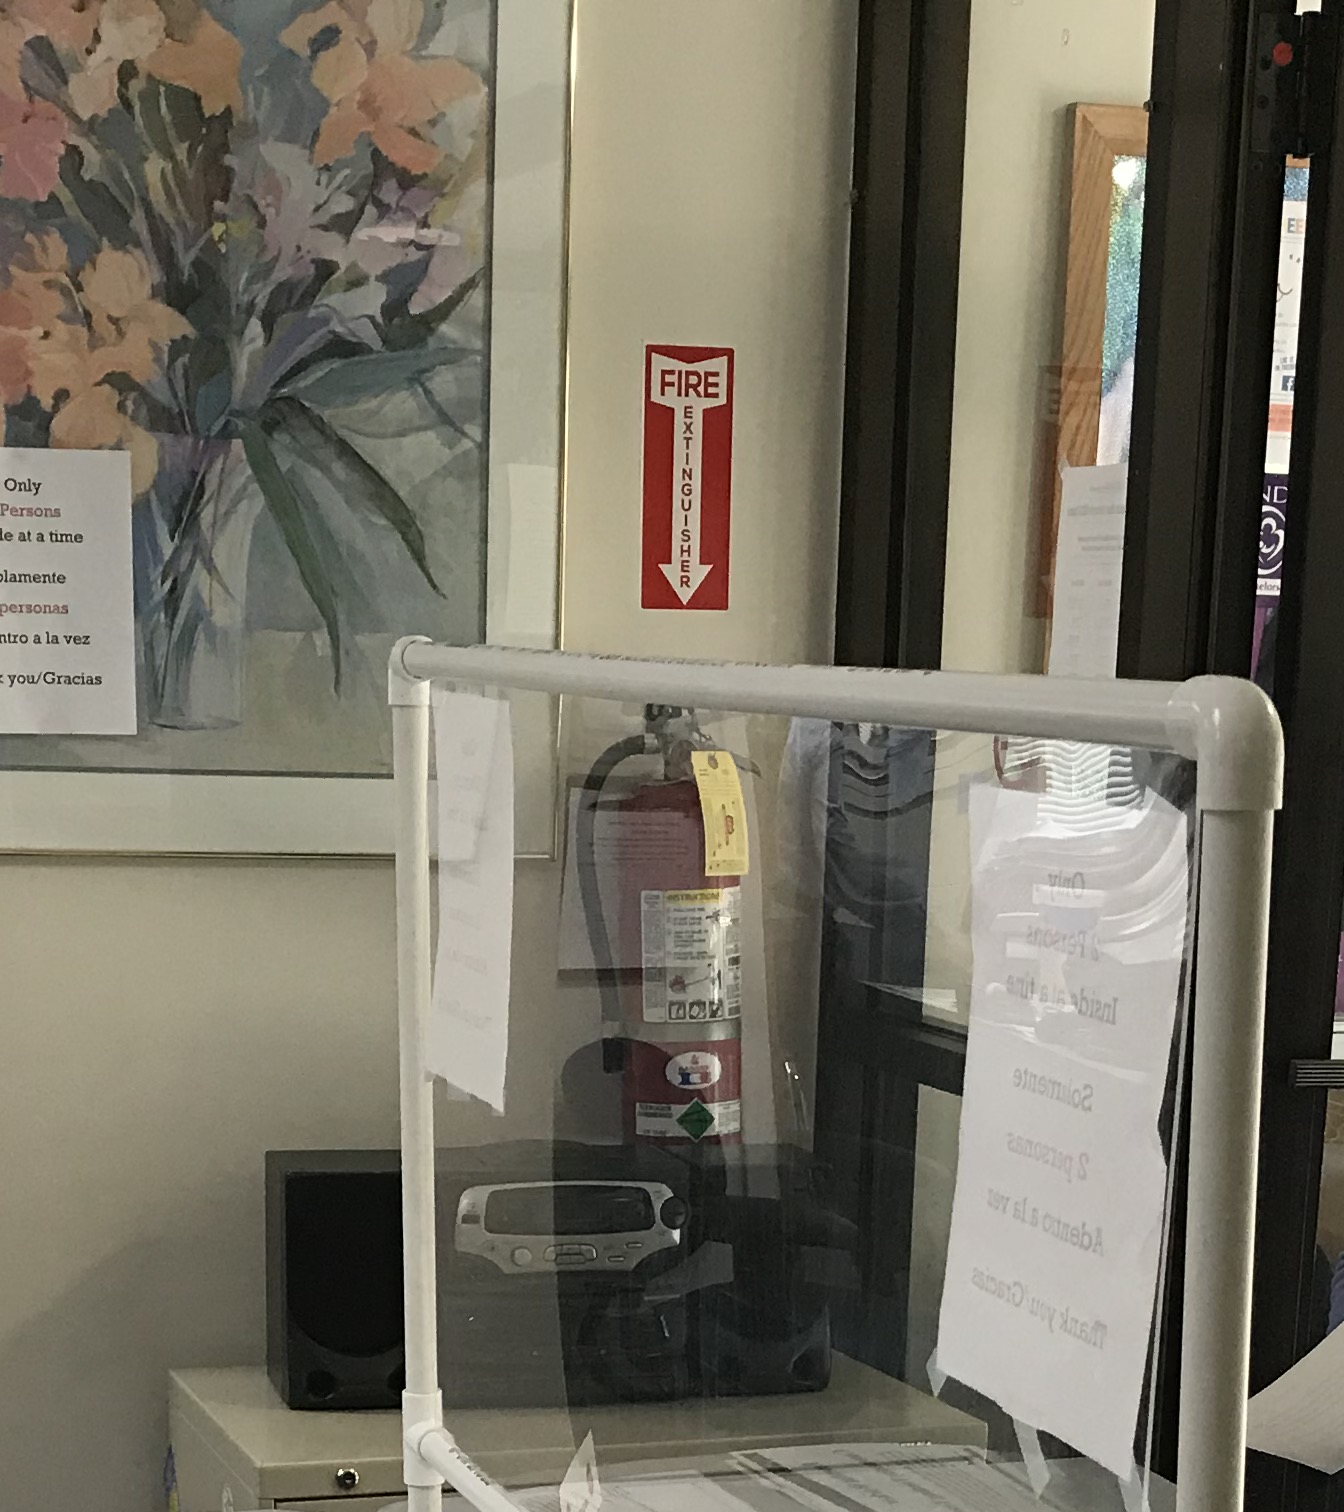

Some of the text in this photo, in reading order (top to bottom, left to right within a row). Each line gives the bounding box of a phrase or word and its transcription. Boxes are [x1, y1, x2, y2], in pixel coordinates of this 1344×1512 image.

[660, 370, 720, 399] FIRE
[4, 478, 42, 496] Only
[679, 405, 693, 588] EXTINGUISHER
[0, 504, 61, 518] Persons
[17, 529, 32, 543] at
[36, 532, 45, 543] a
[49, 530, 84, 544] time
[33, 633, 42, 645] a
[45, 632, 59, 645] la
[64, 633, 90, 646] vez
[7, 671, 103, 688] you/Gracias
